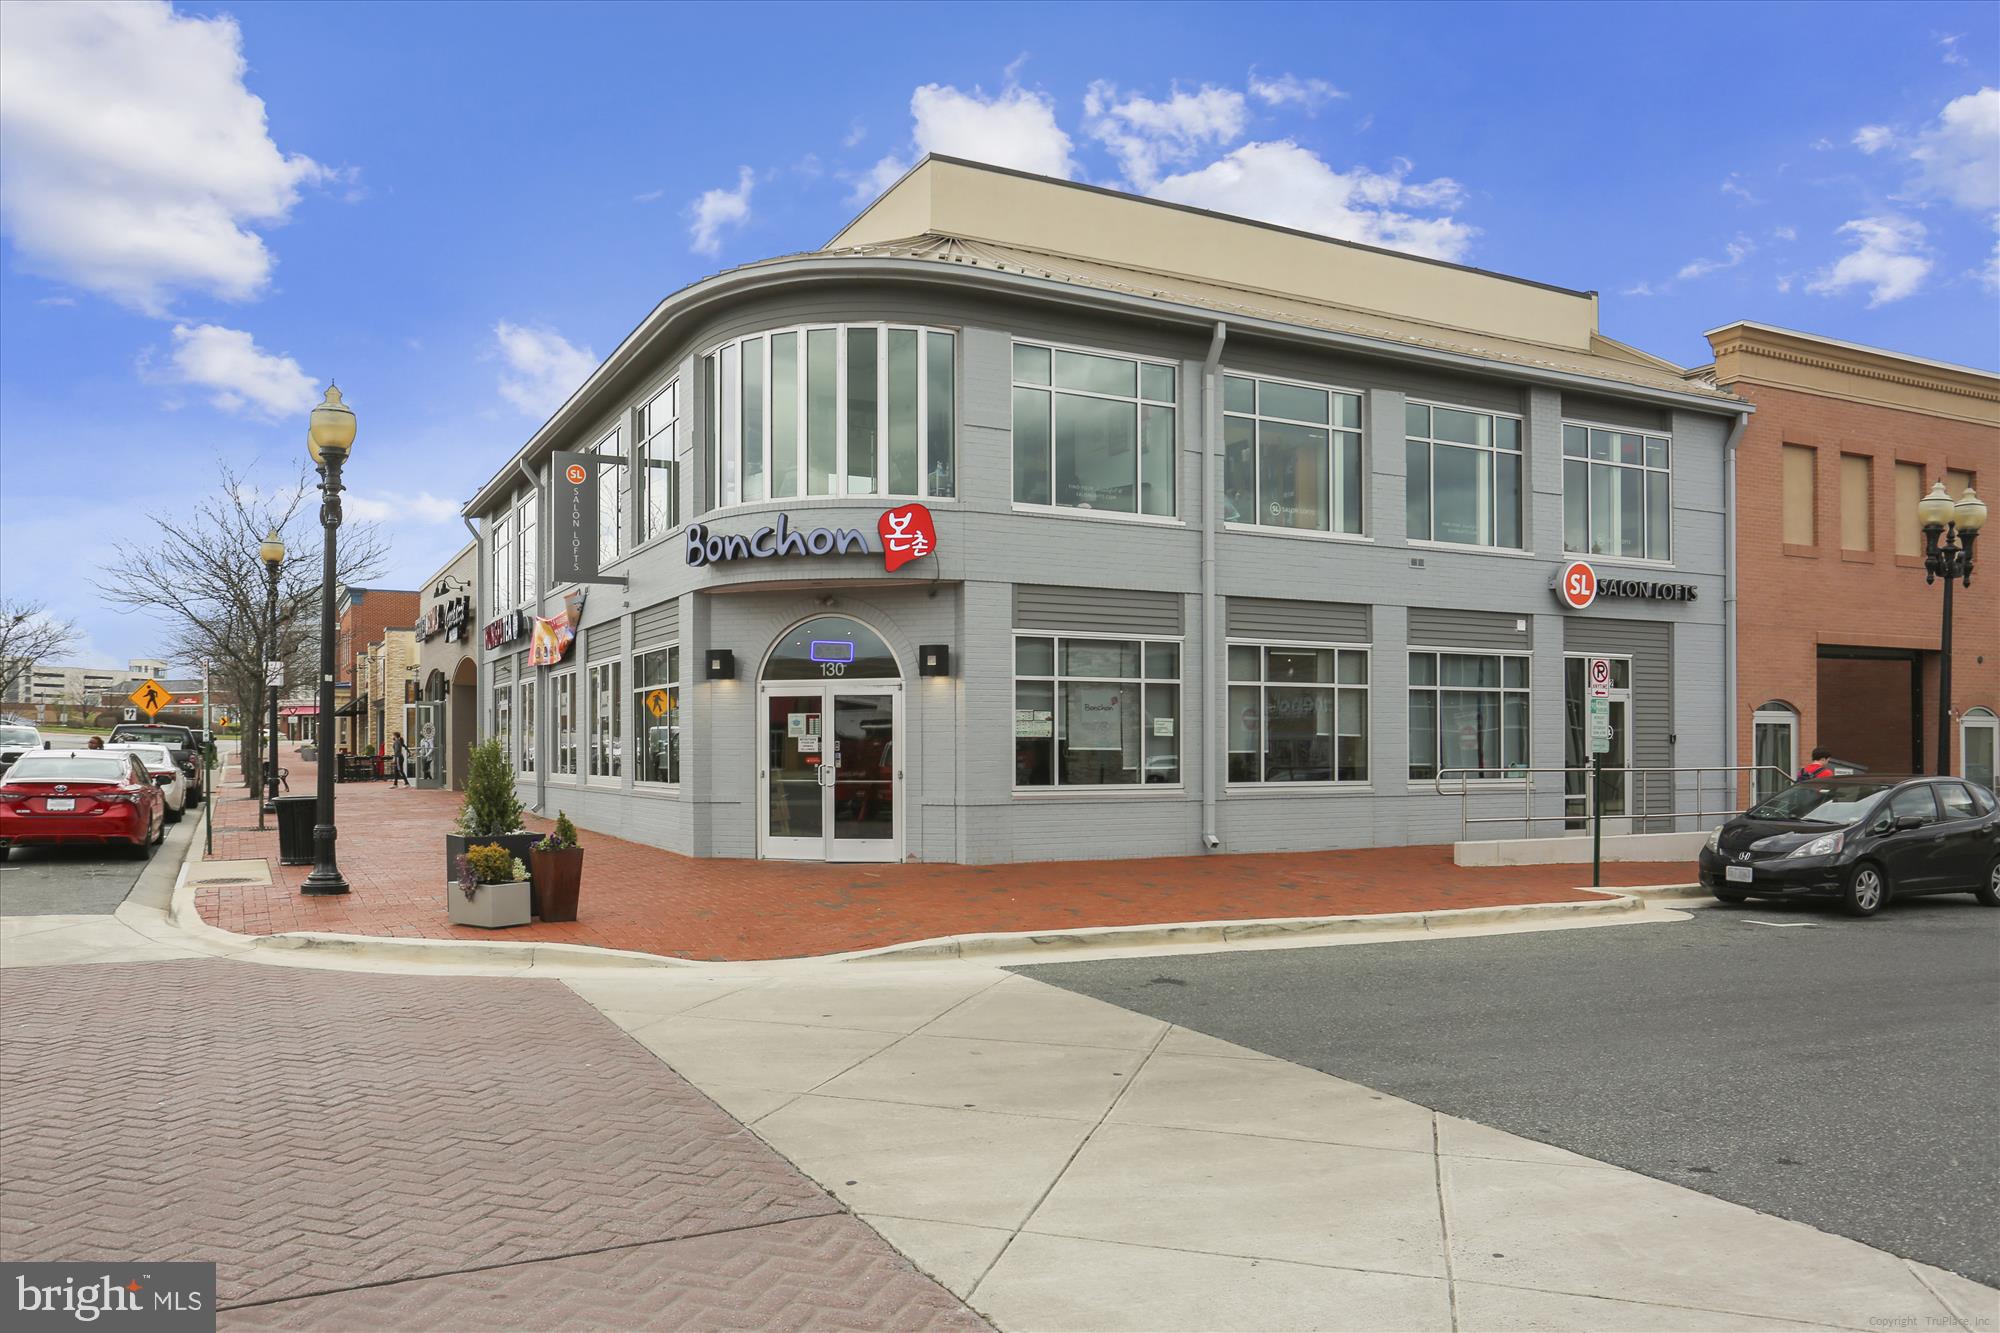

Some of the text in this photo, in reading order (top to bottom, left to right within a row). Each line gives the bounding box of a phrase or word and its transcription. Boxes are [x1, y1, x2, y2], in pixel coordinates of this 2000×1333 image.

[569, 469, 583, 479] SL
[572, 487, 580, 571] SALON LOFTS
[684, 513, 869, 567] Bonchon
[884, 511, 928, 557] 본촌
[1570, 573, 1590, 595] SL
[1600, 579, 1698, 601] SALON LOFTS
[820, 662, 844, 677] 130
